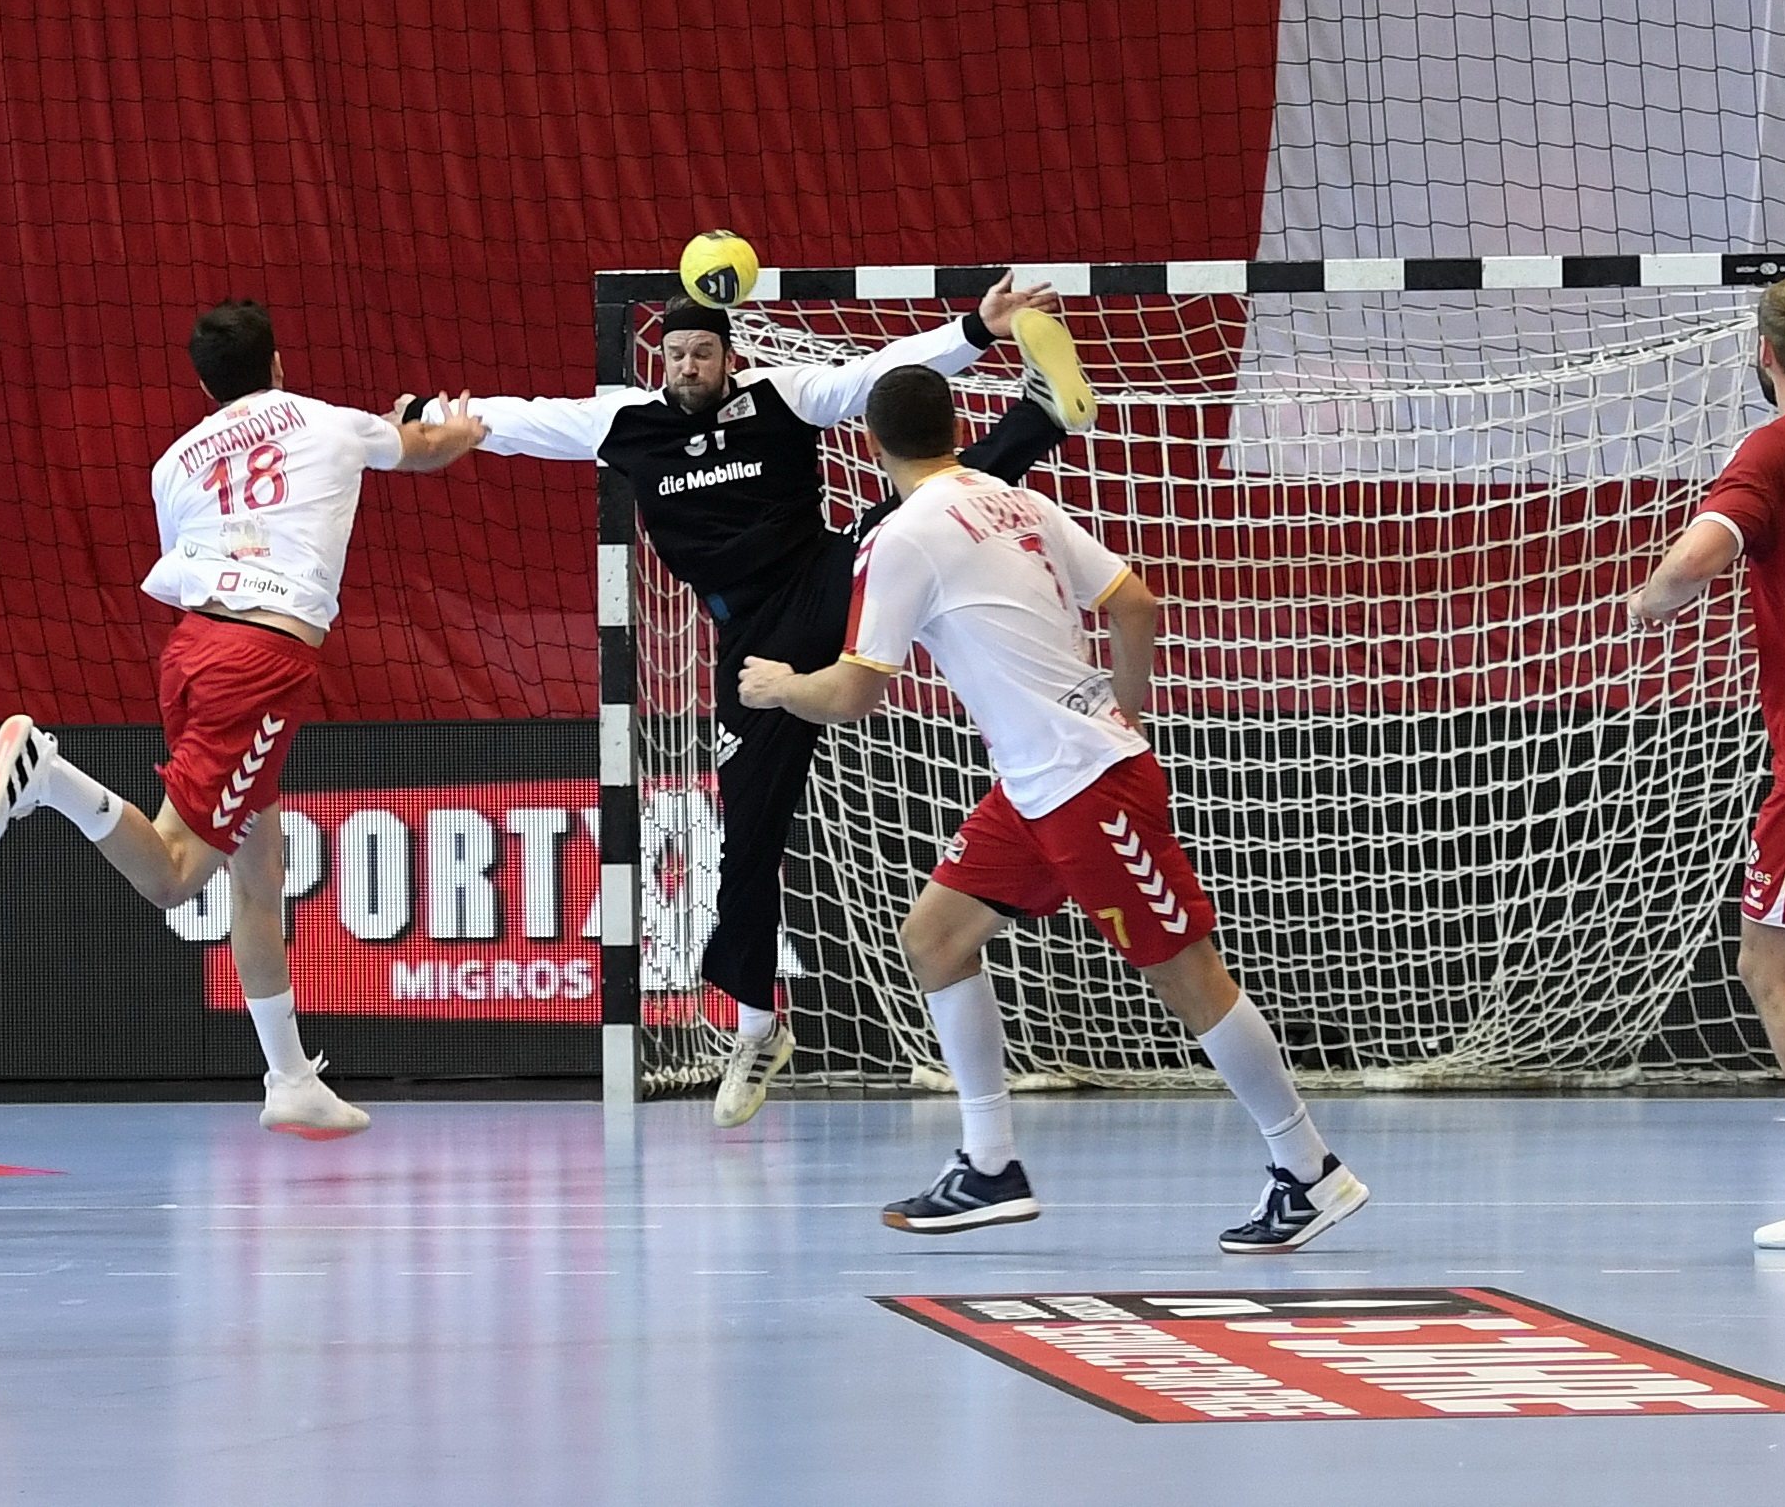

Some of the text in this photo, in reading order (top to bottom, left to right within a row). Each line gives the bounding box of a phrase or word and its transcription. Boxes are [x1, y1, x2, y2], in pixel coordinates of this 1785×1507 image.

[200, 439, 290, 516] 18
[242, 577, 289, 597] triglav
[1093, 907, 1132, 949] 7
[392, 958, 593, 1001] MIGROS
